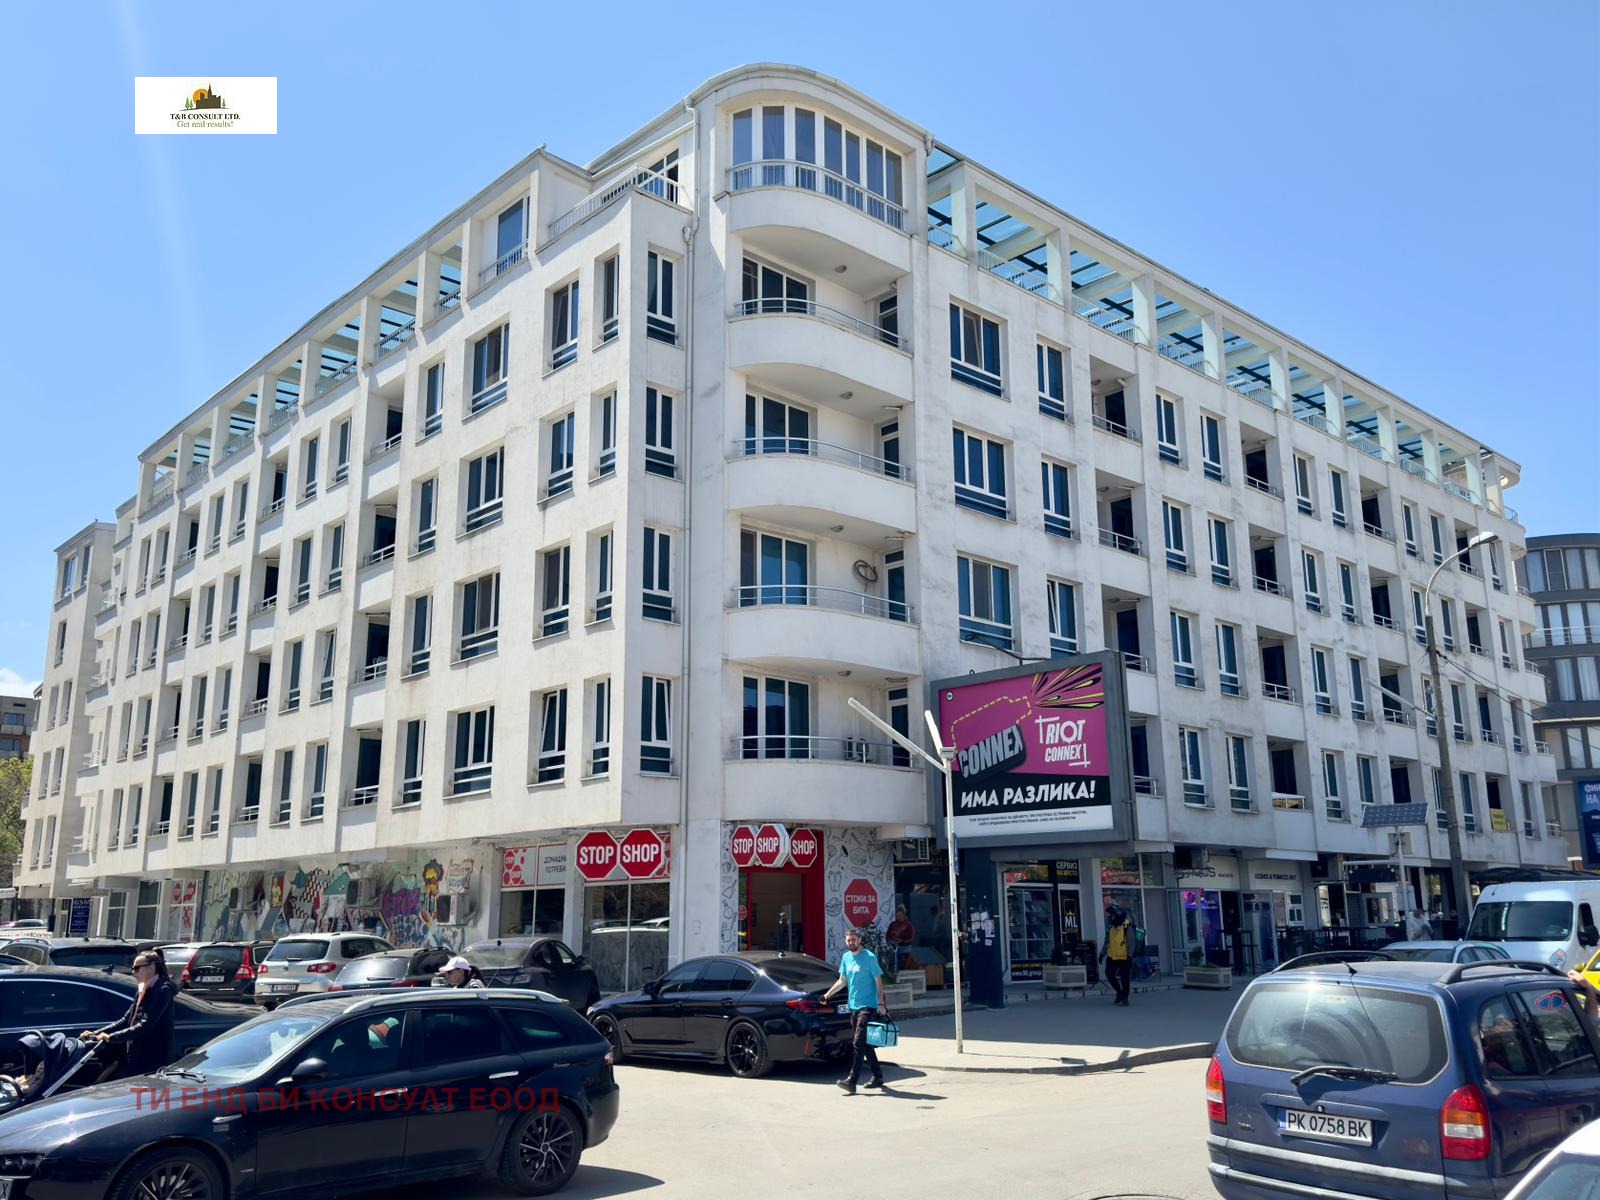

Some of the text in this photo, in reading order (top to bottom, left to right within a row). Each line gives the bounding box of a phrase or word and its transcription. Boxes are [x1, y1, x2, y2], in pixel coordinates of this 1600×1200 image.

[958, 724, 1023, 778] CONNEX
[1044, 744, 1082, 763] CONNEX
[960, 780, 1096, 809] ИМА РАЗЛИКА!
[579, 843, 660, 865] STOP SHOP
[733, 837, 779, 854] STOP SHOP
[792, 840, 815, 855] SHOP
[845, 894, 876, 904] СТОКИ ЗА
[853, 906, 869, 915] БИТА
[1287, 1111, 1368, 1139] PK 0758 BK
